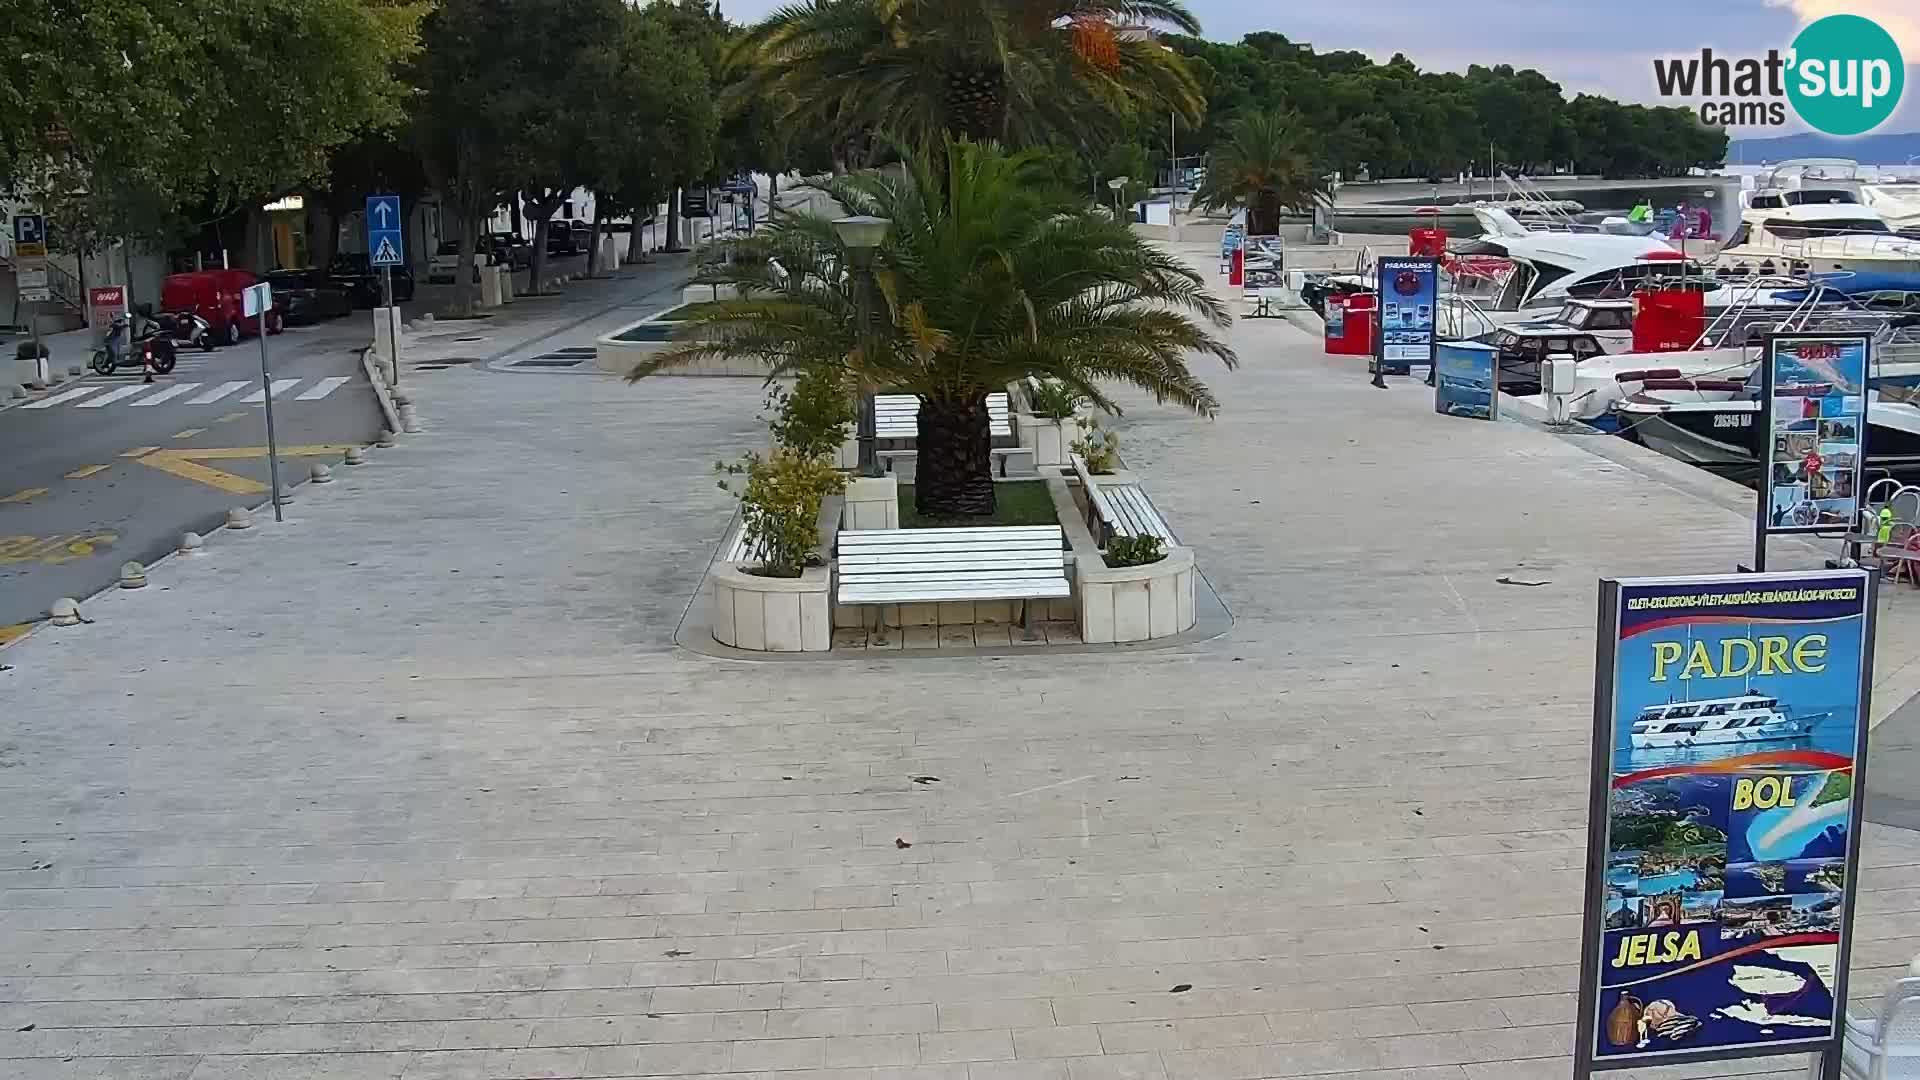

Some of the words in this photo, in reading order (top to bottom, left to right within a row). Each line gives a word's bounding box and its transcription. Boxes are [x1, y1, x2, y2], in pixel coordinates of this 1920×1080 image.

[18, 217, 34, 241] P
[1649, 634, 1829, 683] PADRE
[1733, 775, 1796, 810] BOL
[1612, 930, 1701, 968] JELSA
